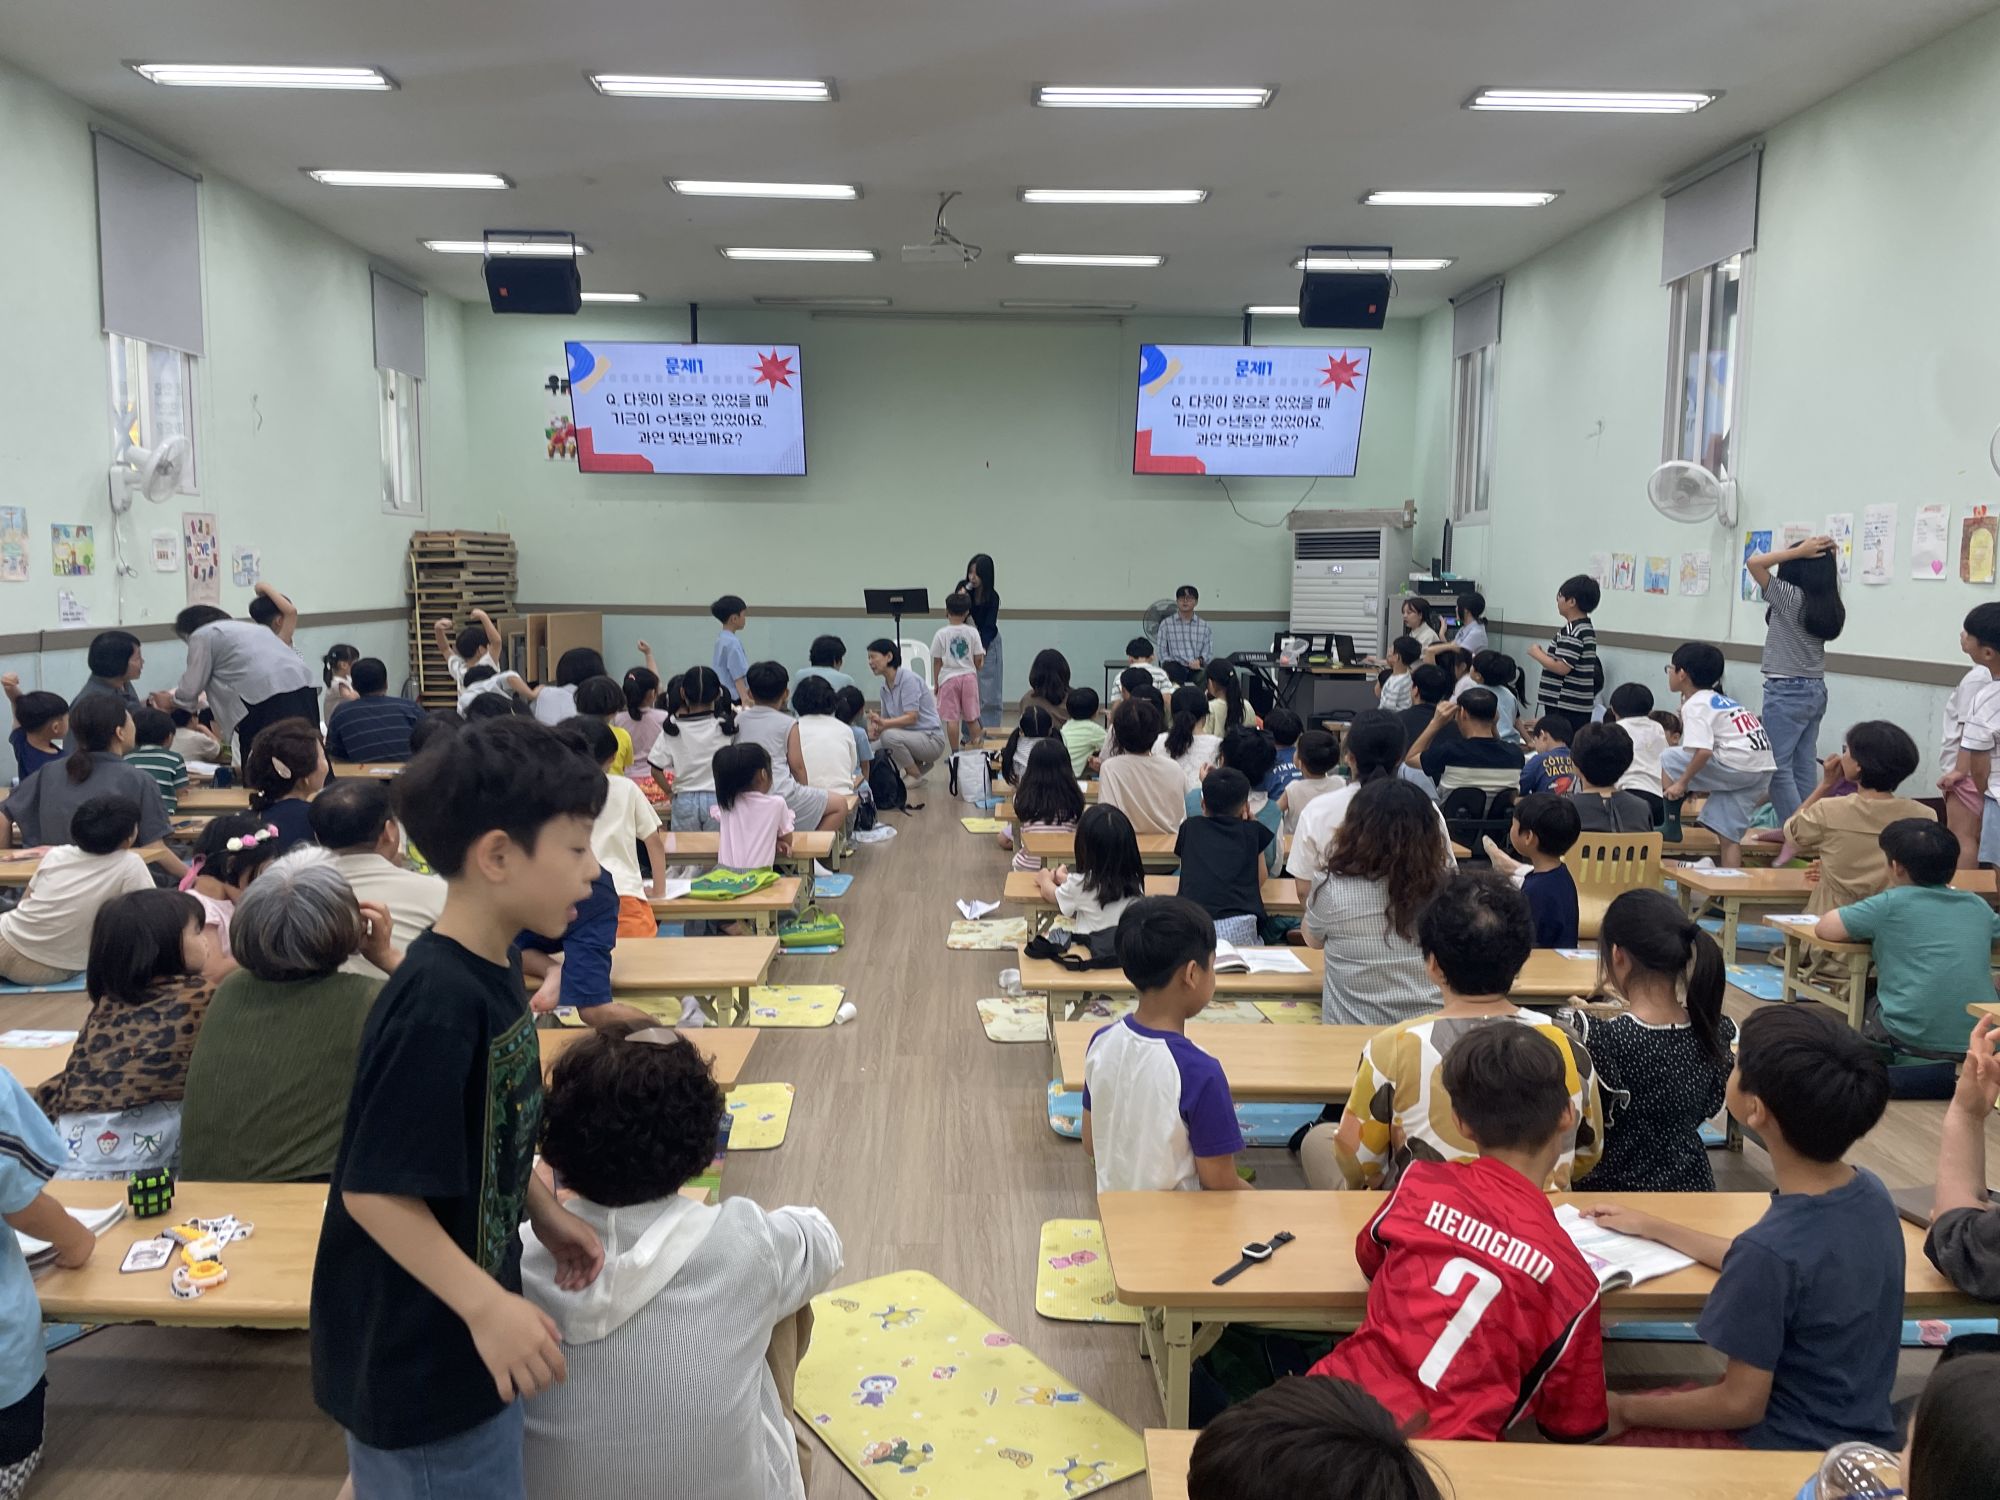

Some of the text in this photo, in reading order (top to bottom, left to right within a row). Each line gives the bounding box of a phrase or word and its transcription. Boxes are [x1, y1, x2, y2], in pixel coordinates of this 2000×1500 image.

[665, 357, 704, 375] 문제1
[1235, 359, 1273, 378] 문제1
[624, 392, 664, 408] 다윗이
[668, 392, 707, 408] 왕으로
[711, 393, 751, 409] 있었을
[755, 393, 769, 408] 때
[1188, 394, 1228, 410] 다윗이
[1232, 394, 1270, 409] 왕으로
[1275, 394, 1313, 411] 있었을
[1317, 395, 1331, 409] 때
[611, 412, 650, 426] 기근이
[1173, 413, 1211, 428] 기근이
[638, 430, 743, 446] 과연 몇년일까요?
[1226, 432, 1299, 448] 몇년일까요?
[1245, 653, 1267, 661] YAMAHA
[1424, 1200, 1555, 1284] HEUNGMIN
[1418, 1257, 1503, 1393] 7
